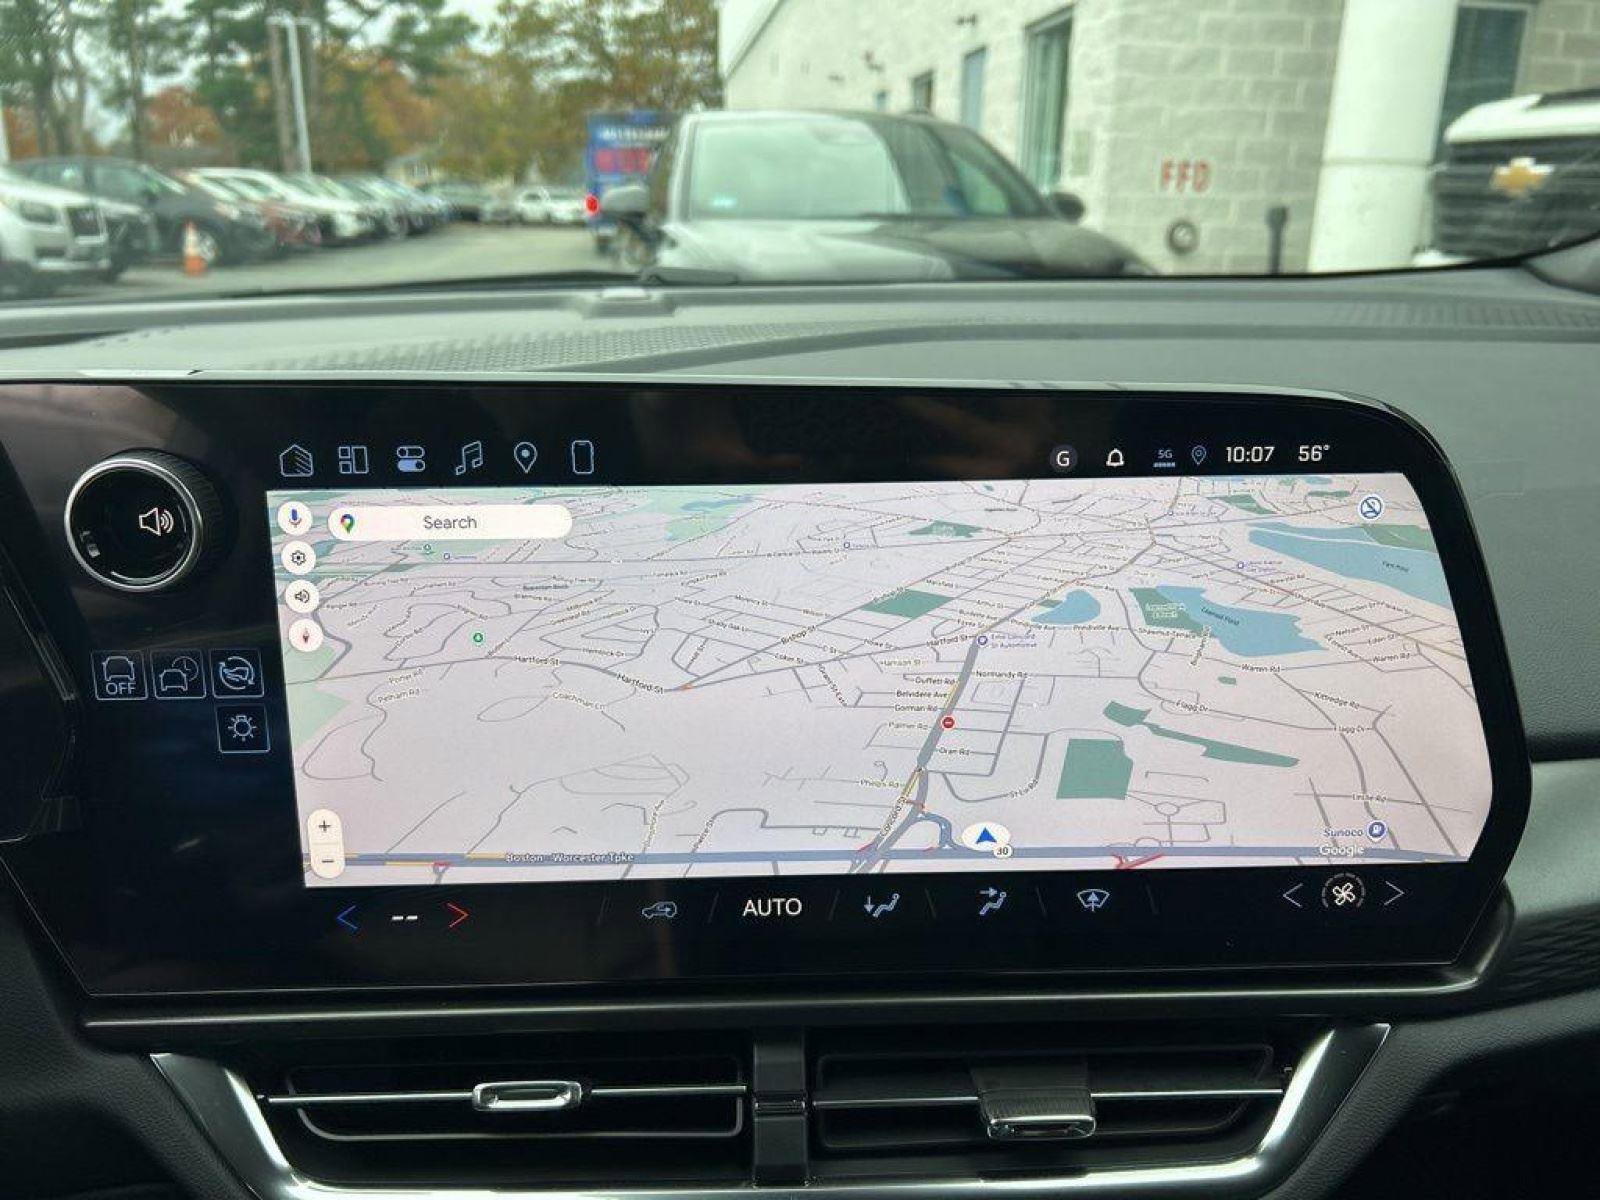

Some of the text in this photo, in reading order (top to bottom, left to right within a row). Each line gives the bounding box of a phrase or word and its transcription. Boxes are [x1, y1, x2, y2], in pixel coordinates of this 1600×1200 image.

[1056, 451, 1070, 467] G
[1157, 450, 1173, 459] 5G
[1226, 446, 1275, 463] 10:07
[1298, 445, 1330, 462] 56°
[423, 515, 477, 530] Search
[515, 655, 559, 665] Hartford St
[1241, 663, 1280, 673] Warren Rd
[975, 671, 1015, 679] Normandy
[105, 682, 136, 695] OFF
[617, 673, 664, 694] Hartford St
[894, 704, 926, 712] Gorman
[1323, 827, 1364, 837] Sunoco
[997, 847, 1008, 855] 30
[1319, 844, 1365, 857] Google
[505, 853, 634, 864] Boston Worcester Tpke
[743, 899, 803, 917] AUTO
